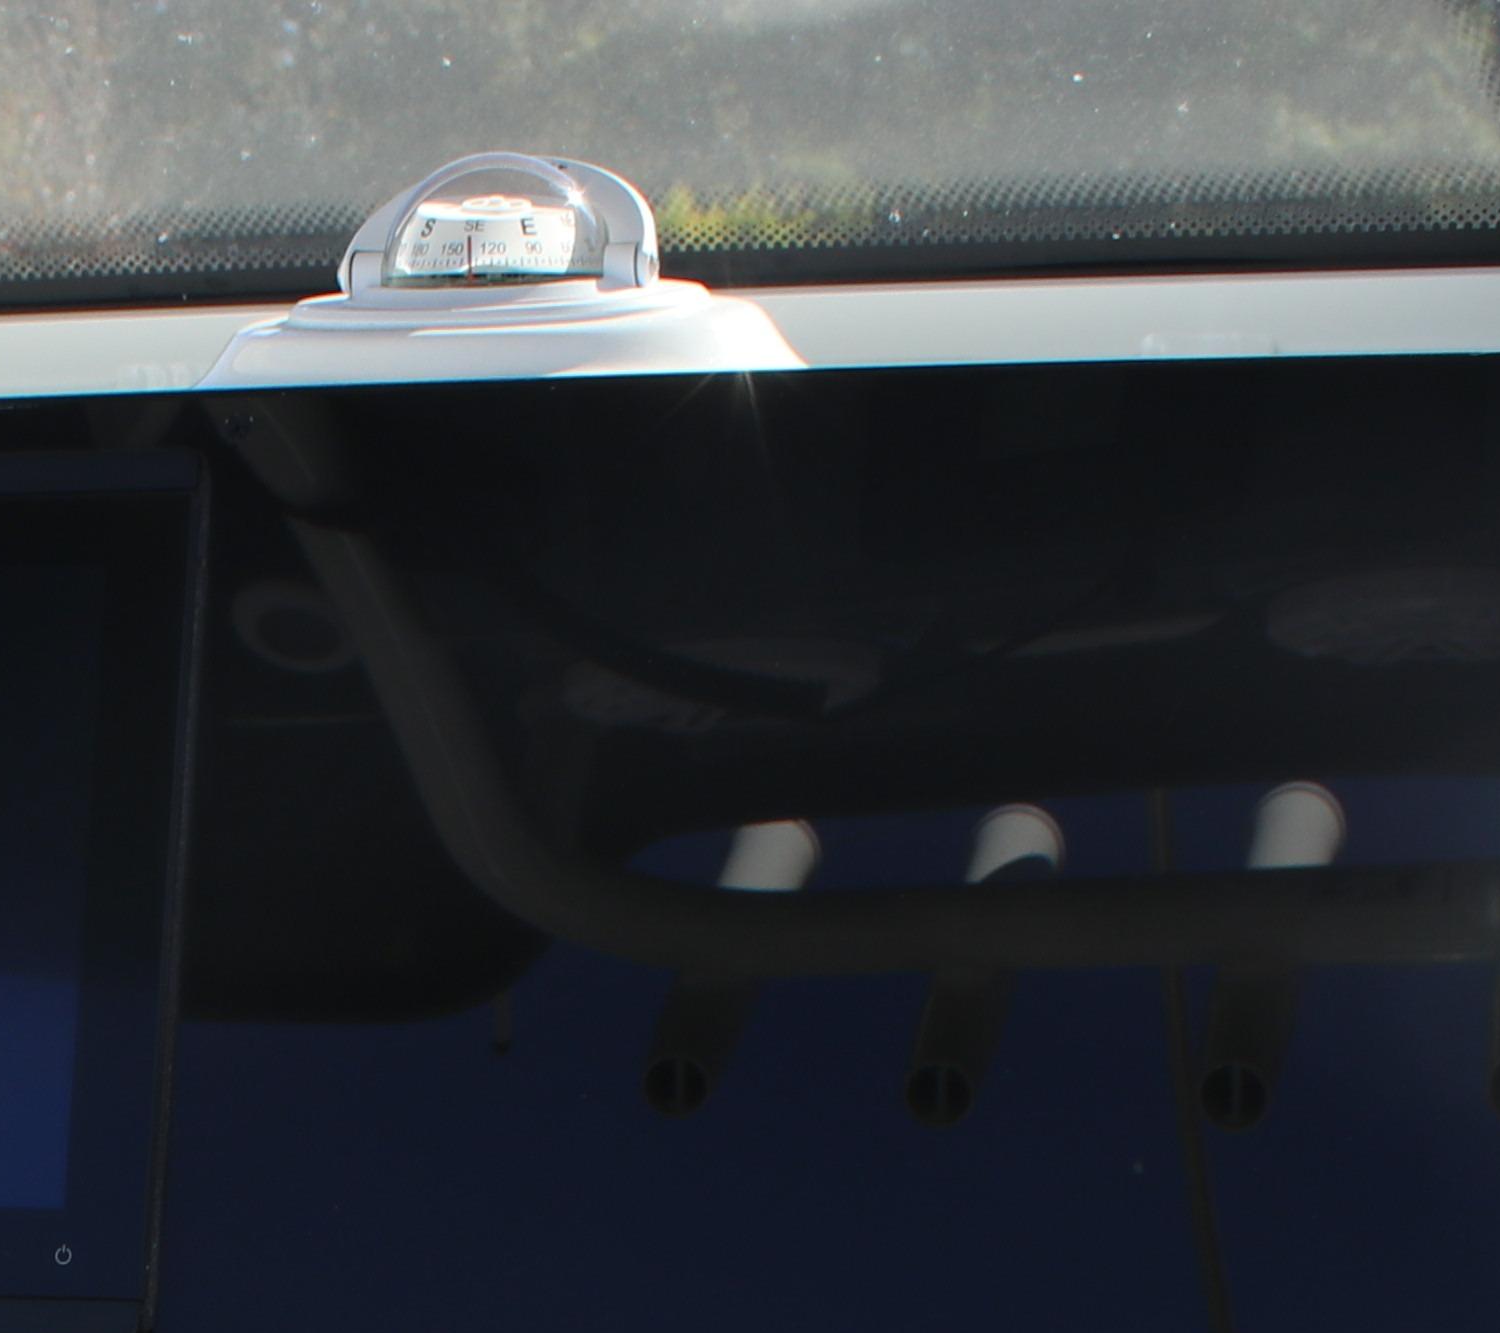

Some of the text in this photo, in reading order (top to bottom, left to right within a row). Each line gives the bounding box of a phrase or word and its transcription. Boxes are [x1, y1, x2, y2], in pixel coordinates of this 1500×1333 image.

[421, 218, 437, 237] S
[464, 220, 485, 232] SE
[520, 217, 537, 236] E
[440, 242, 464, 256] 150
[480, 241, 507, 255] 120
[524, 241, 543, 255] 90
